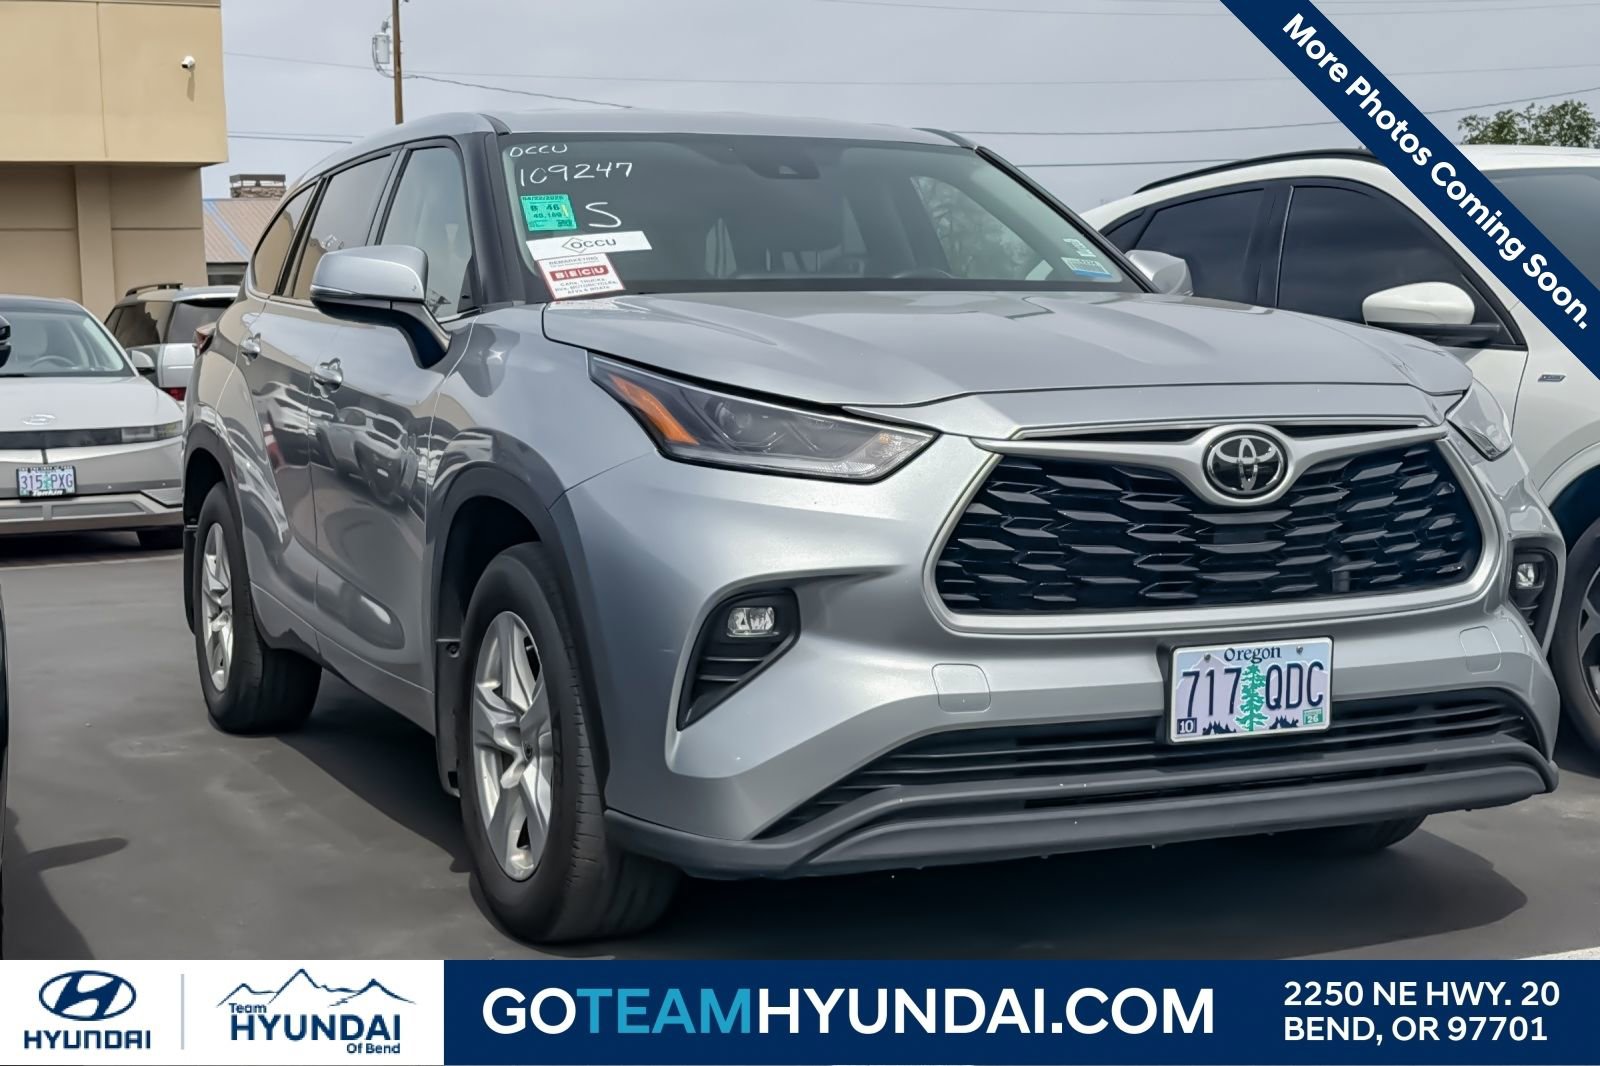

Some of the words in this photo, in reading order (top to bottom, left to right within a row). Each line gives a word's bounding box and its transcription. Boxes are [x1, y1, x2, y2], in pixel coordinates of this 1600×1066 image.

[509, 144, 568, 158] OCCU
[520, 162, 633, 187] 109247
[570, 238, 617, 250] OCCU
[21, 475, 43, 489] 315
[50, 473, 73, 488] PXG
[1224, 646, 1282, 663] Oregon
[1182, 666, 1242, 717] 717
[1265, 661, 1325, 711] QDC
[1180, 719, 1194, 733] 10
